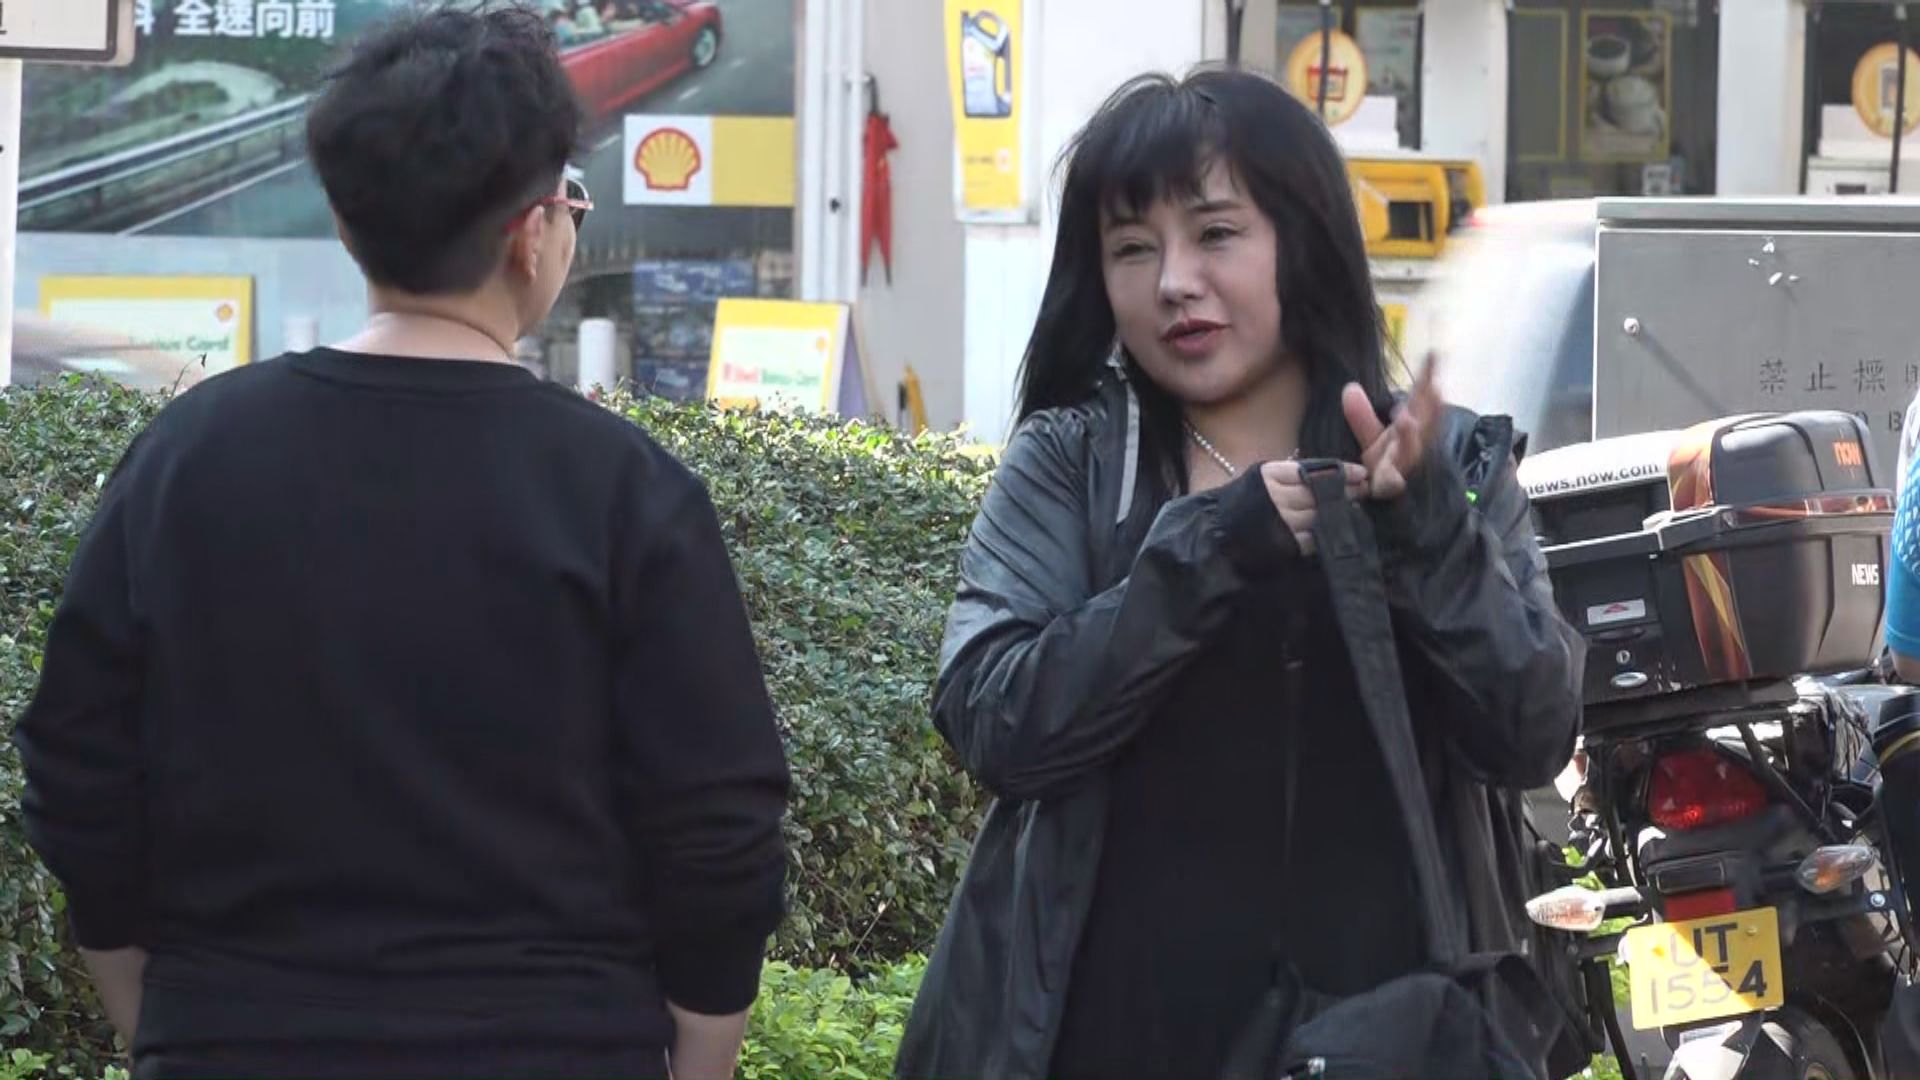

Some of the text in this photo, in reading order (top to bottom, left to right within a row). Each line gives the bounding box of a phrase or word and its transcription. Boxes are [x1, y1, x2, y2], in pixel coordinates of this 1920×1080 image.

[173, 0, 335, 37] 全速向前
[1851, 563, 1879, 585] NEWS
[1670, 922, 1738, 967] UT
[1651, 960, 1767, 1014] 1554
